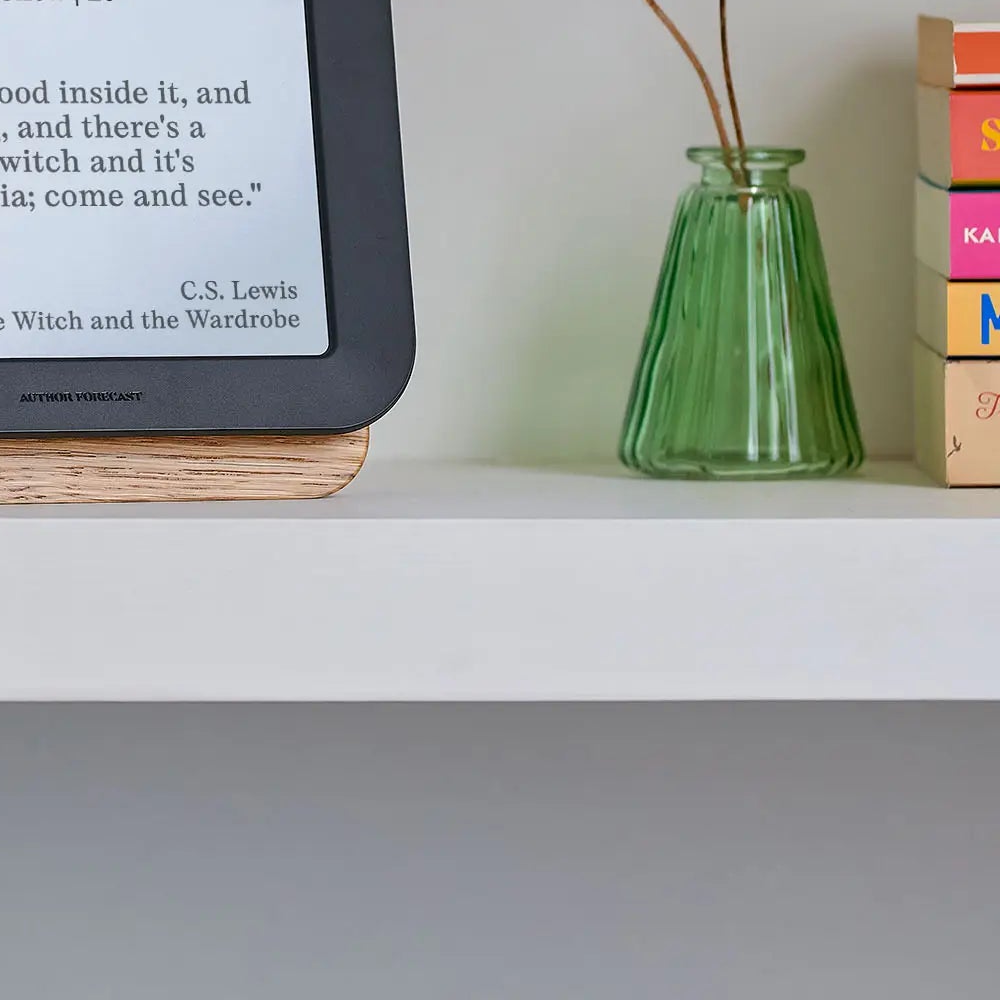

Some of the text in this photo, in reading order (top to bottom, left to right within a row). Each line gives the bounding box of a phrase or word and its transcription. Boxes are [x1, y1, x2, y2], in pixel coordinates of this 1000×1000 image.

[59, 80, 148, 104] inside
[158, 81, 187, 108] it,
[197, 80, 251, 104] and
[18, 114, 72, 138] and
[81, 114, 179, 138] there's
[190, 121, 205, 138] a
[91, 149, 145, 173] and
[154, 149, 194, 172] it's
[45, 190, 123, 207] come
[134, 183, 188, 206] and
[198, 183, 261, 206] see."
[963, 226, 1000, 244] KA
[181, 281, 297, 300] C.S. Lewis
[12, 311, 83, 330] Witch
[91, 310, 134, 329] and
[141, 310, 179, 329] the
[185, 309, 300, 328] Wardrobe
[20, 391, 143, 402] AUTHOR FORECAST
